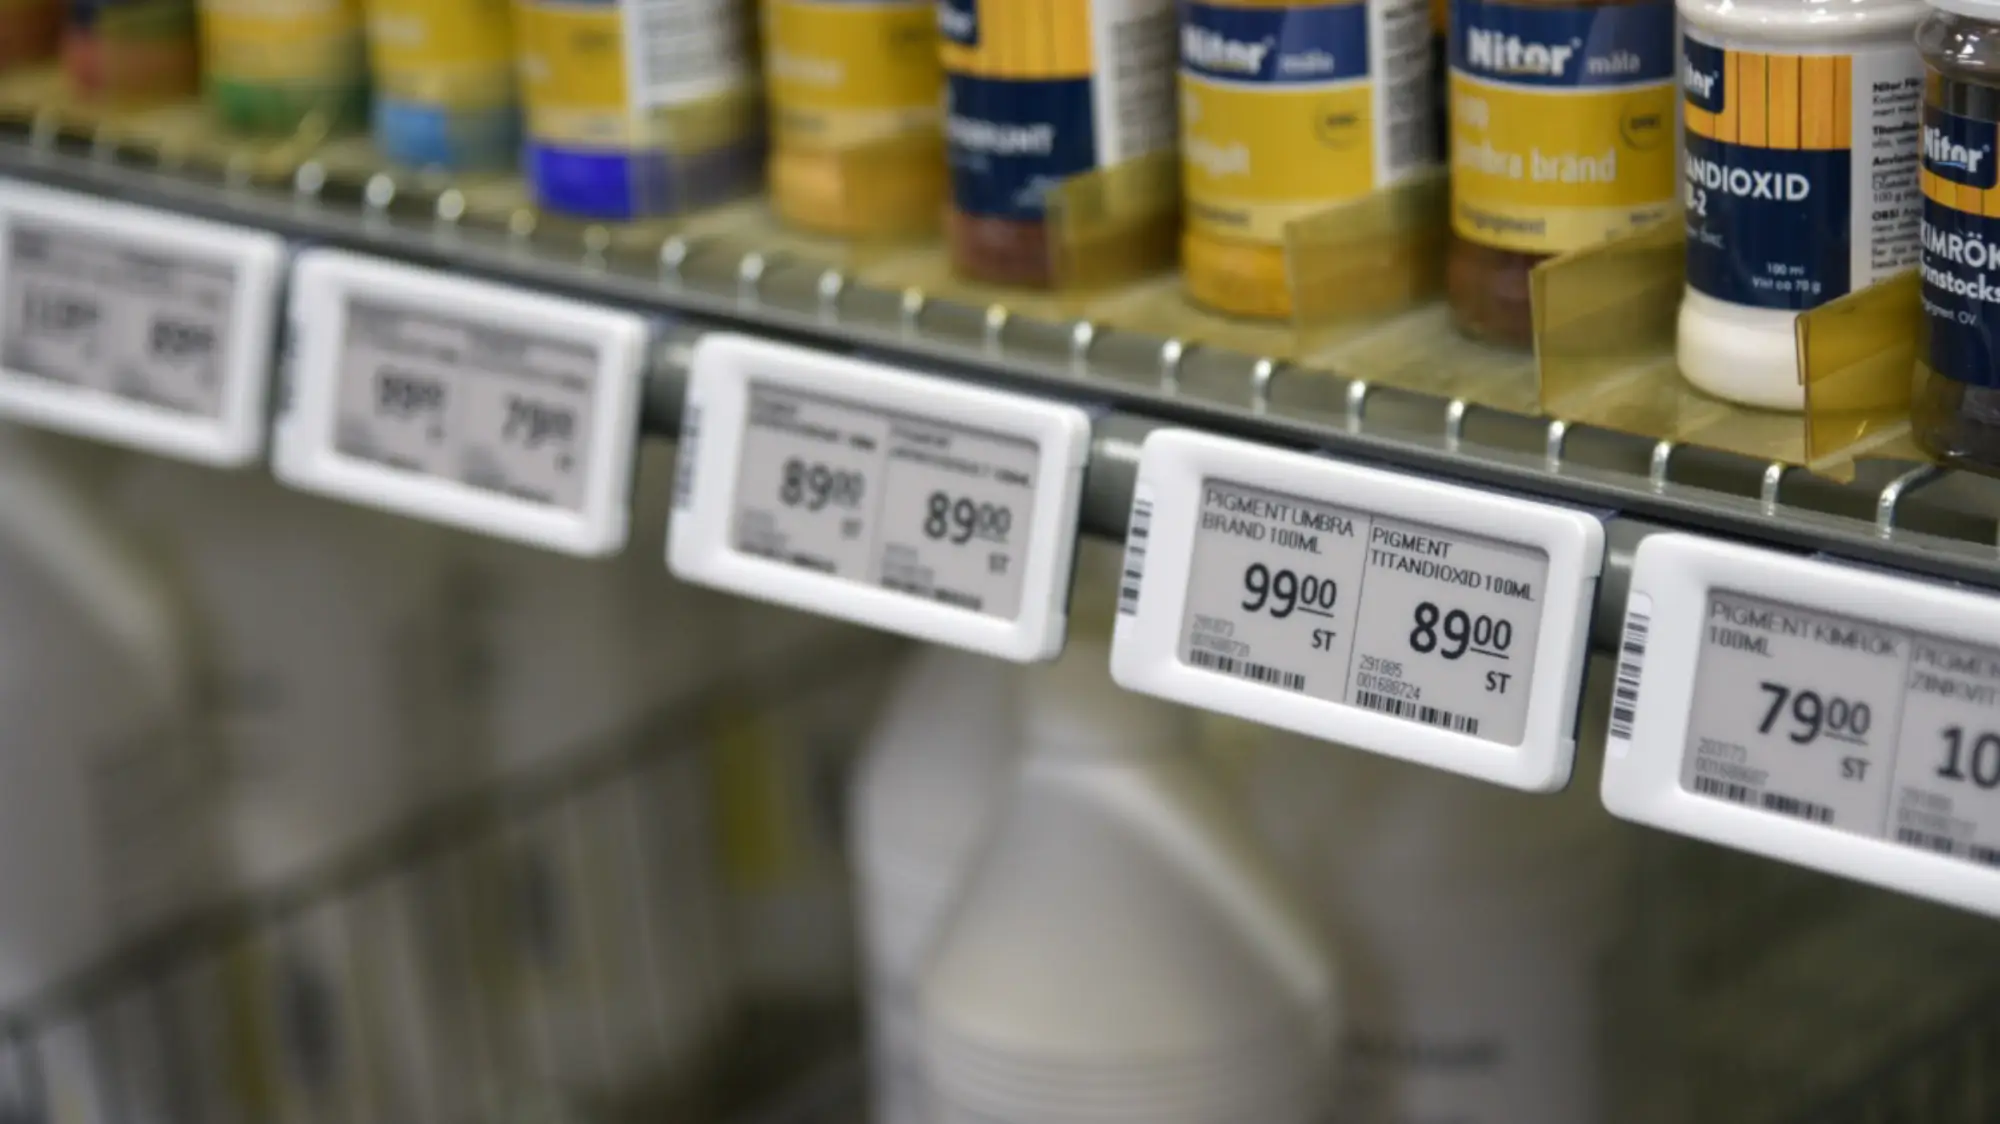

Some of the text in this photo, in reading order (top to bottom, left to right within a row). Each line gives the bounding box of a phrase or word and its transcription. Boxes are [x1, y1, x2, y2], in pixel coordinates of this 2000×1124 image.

[1181, 25, 1266, 74] Nitor
[1468, 25, 1641, 77] Nitor måla
[1923, 124, 1984, 172] Nitor
[1766, 262, 1788, 276] 100
[1201, 512, 1322, 555] BRAND 100ML
[1205, 490, 1355, 538] PIGMENT UMBRA
[1371, 526, 1452, 559] PIGMENT
[1370, 548, 1536, 602] TITANDIOXID 100ML
[1311, 627, 1336, 653] ST
[1710, 600, 1813, 640] PIGMENT
[1709, 625, 1775, 659] 100ML
[1485, 670, 1512, 695] ST
[1841, 756, 1872, 783] ST
